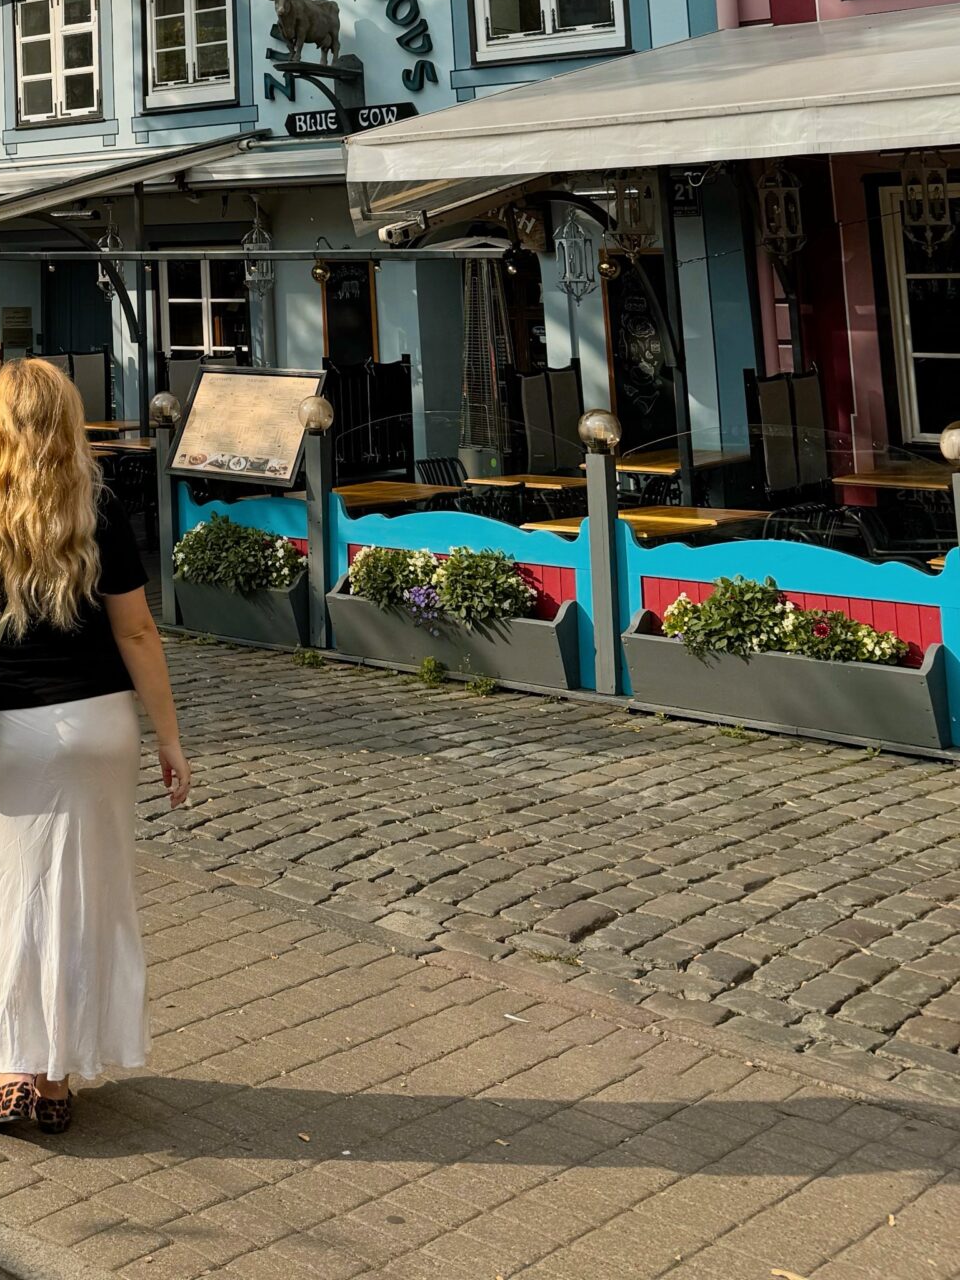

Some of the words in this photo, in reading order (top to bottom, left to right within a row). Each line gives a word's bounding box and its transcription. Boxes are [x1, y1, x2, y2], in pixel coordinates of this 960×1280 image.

[295, 111, 338, 133] BLUE
[358, 106, 398, 126] COW
[674, 183, 693, 200] 21
